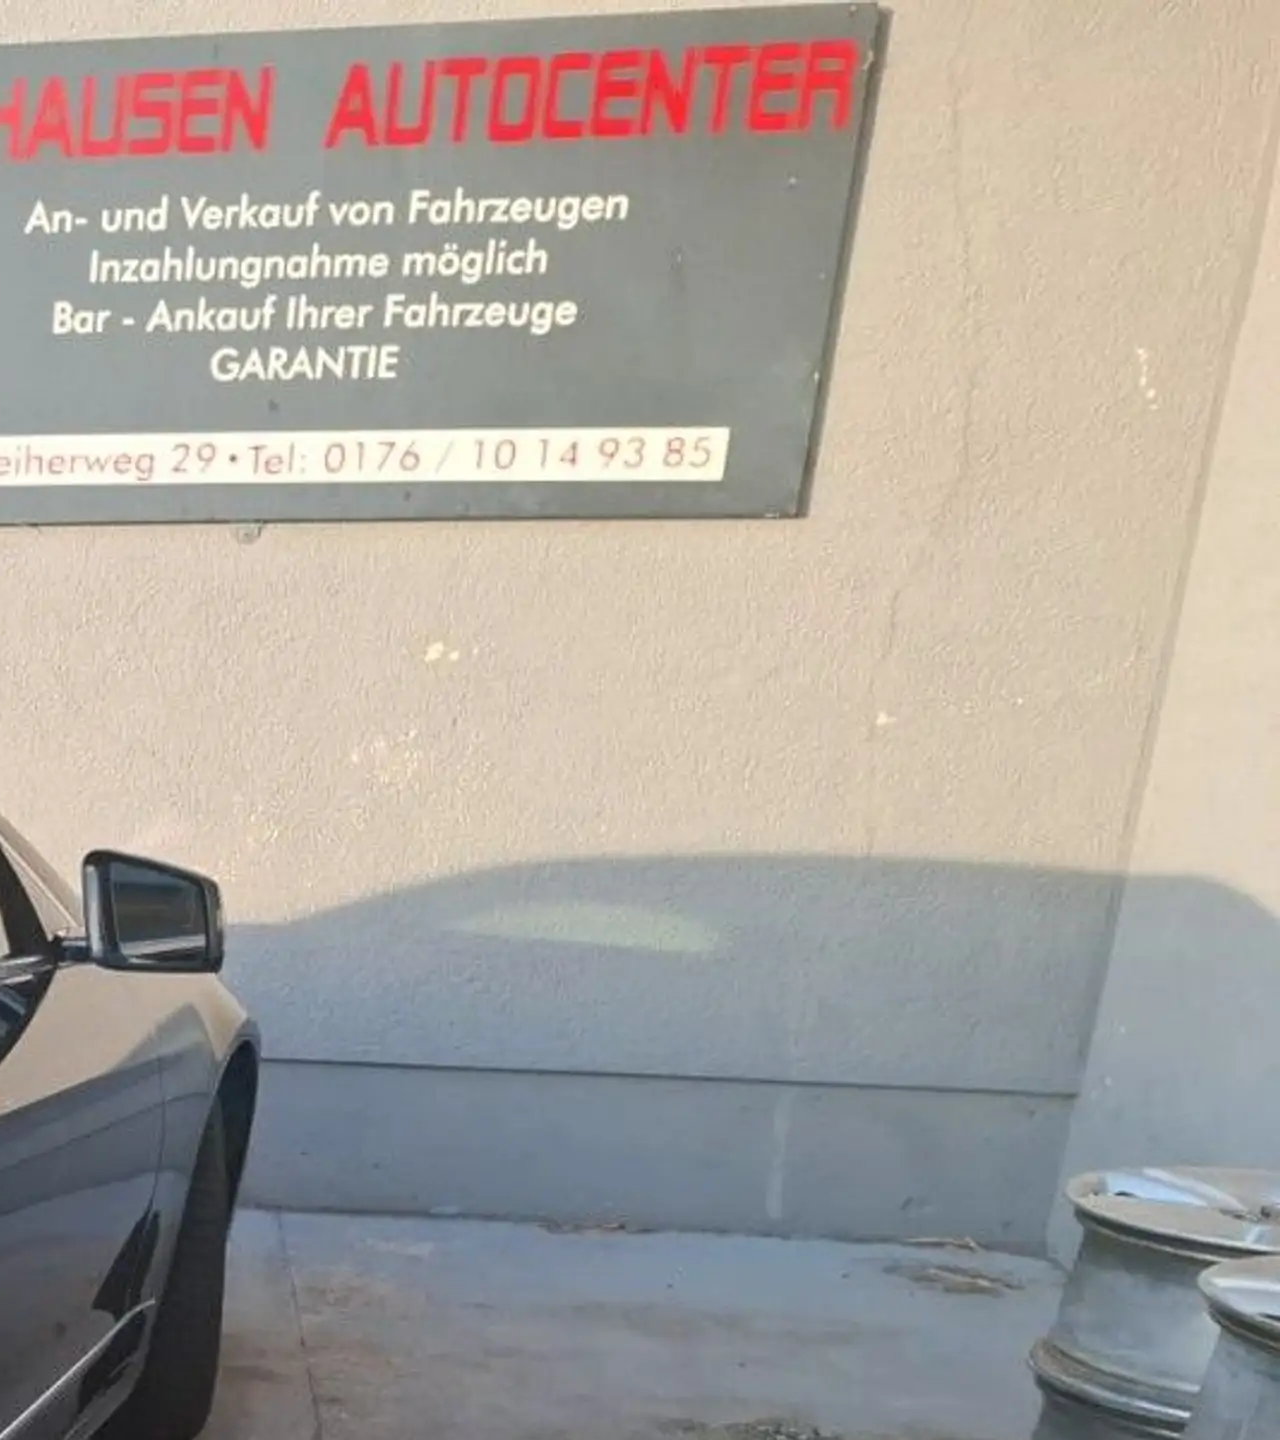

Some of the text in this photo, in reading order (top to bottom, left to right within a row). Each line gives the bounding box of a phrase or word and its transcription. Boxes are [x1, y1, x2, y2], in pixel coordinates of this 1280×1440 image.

[324, 38, 859, 149] AUTOCENTER
[24, 187, 628, 234] An- und Verkauf von Fahrzeugen
[89, 238, 547, 289] Inzahlungnahme möglich
[53, 301, 111, 334] Bar
[146, 294, 277, 332] Ankauf
[287, 294, 373, 329] Ihrer
[384, 292, 577, 335] Fahrzeuge
[210, 345, 400, 381] GARANTIE
[170, 443, 216, 473] 29
[248, 441, 306, 475] Tel:
[324, 440, 420, 474] 0176
[475, 438, 516, 470] 10
[539, 438, 579, 469] 14
[599, 437, 646, 469] 93
[663, 436, 711, 468] 85
